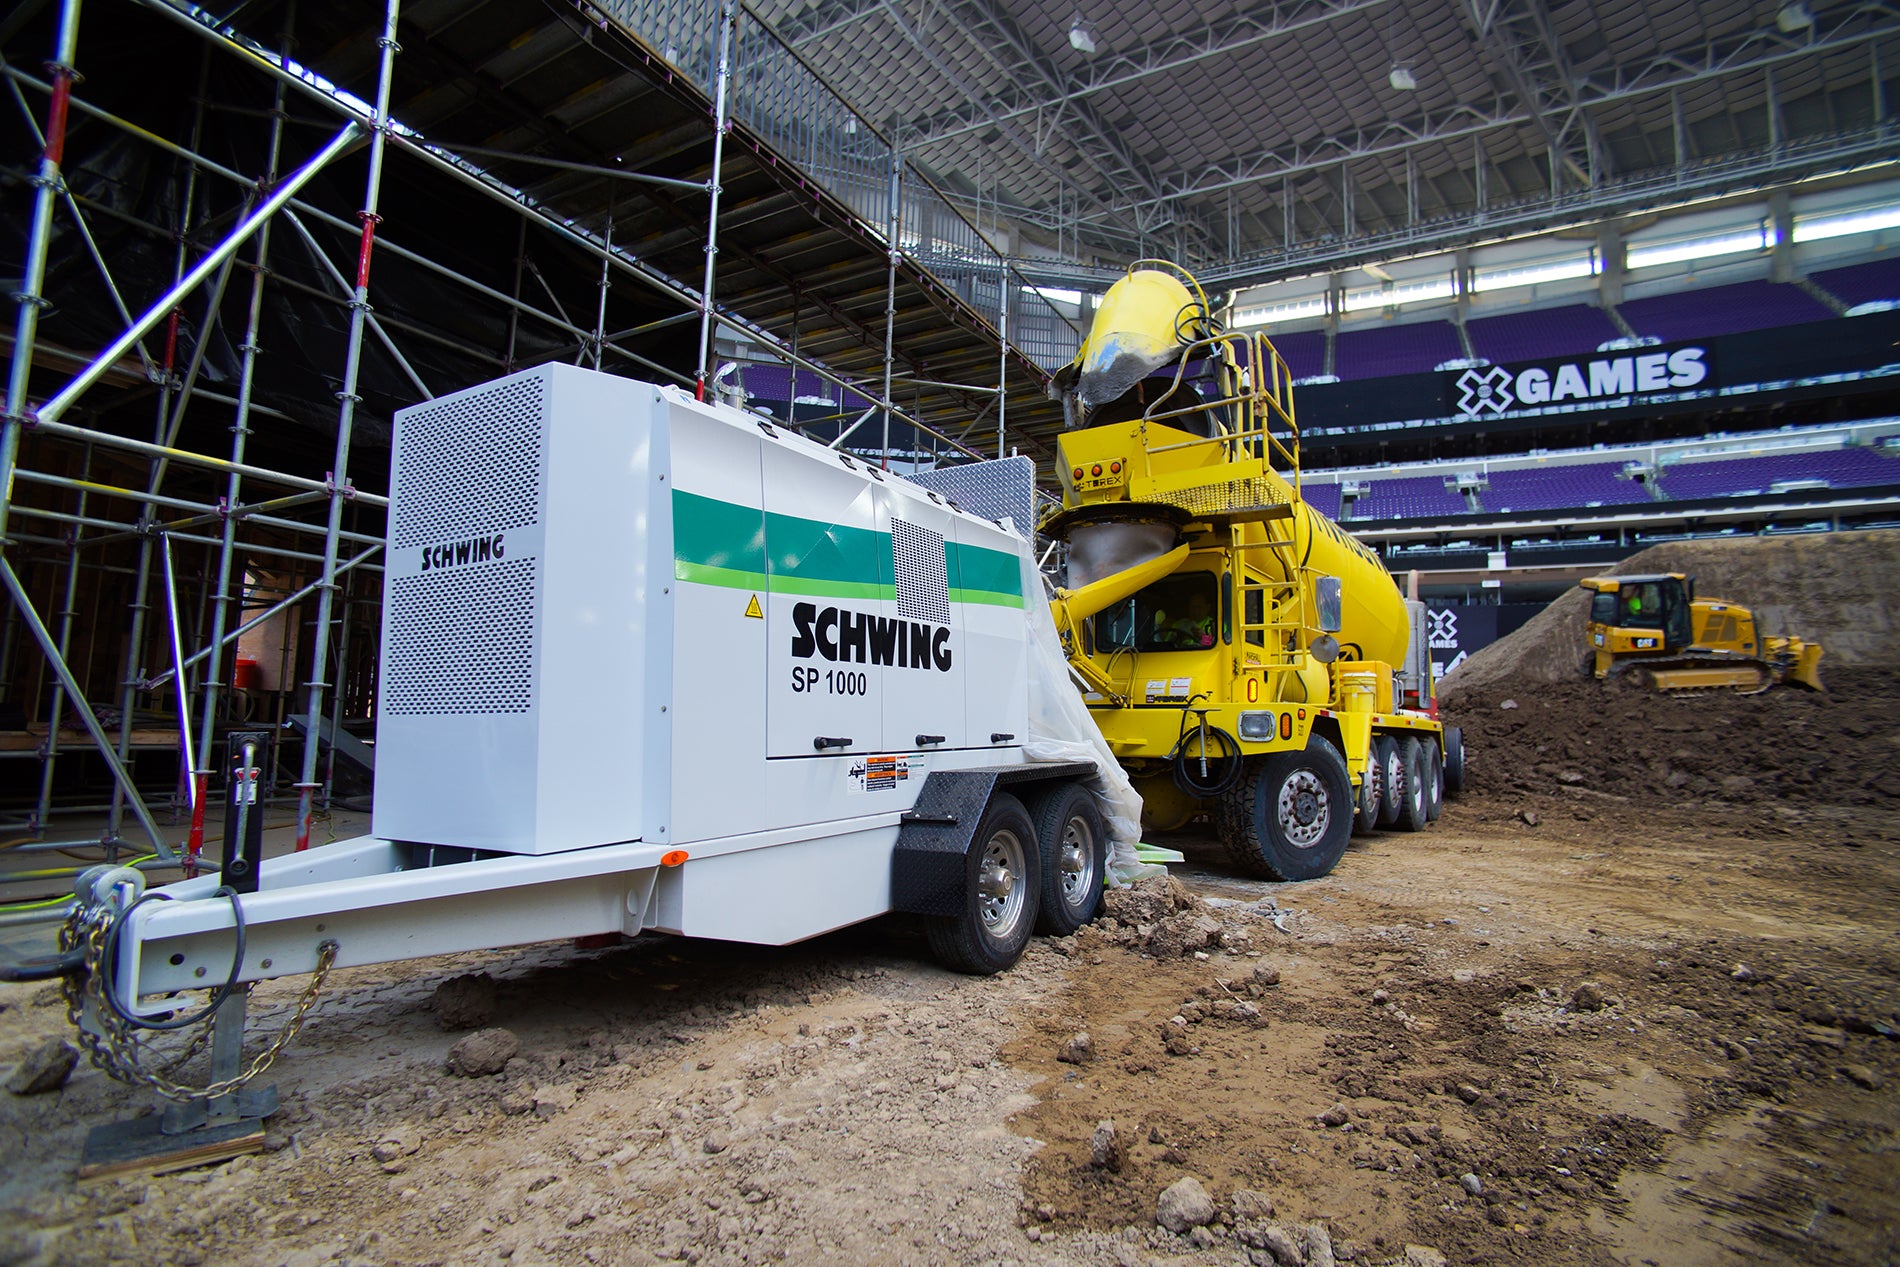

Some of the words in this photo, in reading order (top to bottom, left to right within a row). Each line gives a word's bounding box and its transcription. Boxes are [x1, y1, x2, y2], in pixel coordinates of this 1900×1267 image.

[1515, 347, 1705, 404] GAMES
[422, 534, 504, 571] SCHWING
[792, 602, 952, 672] SCHWING
[1428, 640, 1458, 649] AMES
[1637, 638, 1654, 648] CAT
[792, 666, 819, 692] SP
[826, 669, 867, 696] 1000
